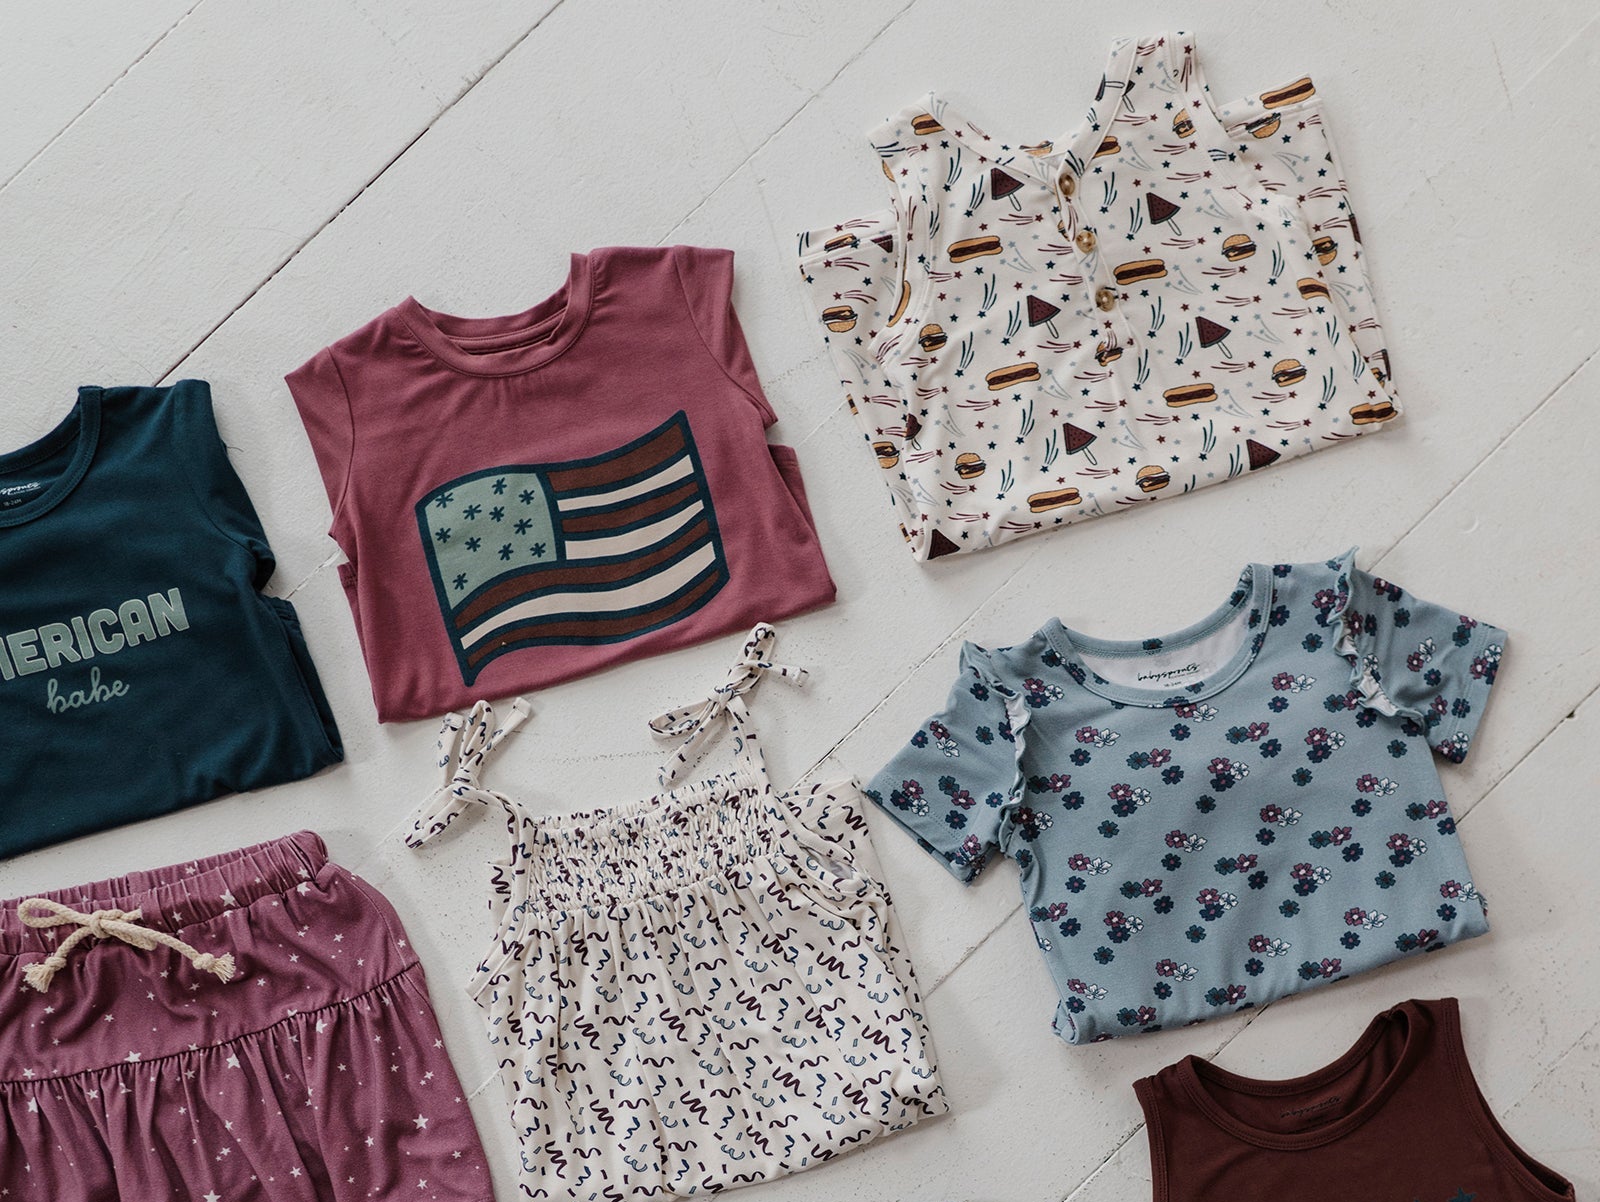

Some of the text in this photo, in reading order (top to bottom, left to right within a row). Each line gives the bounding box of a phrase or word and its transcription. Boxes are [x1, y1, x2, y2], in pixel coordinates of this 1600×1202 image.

[0, 482, 41, 496] sprouts
[1138, 662, 1200, 682] babysprouts
[47, 666, 130, 714] babe
